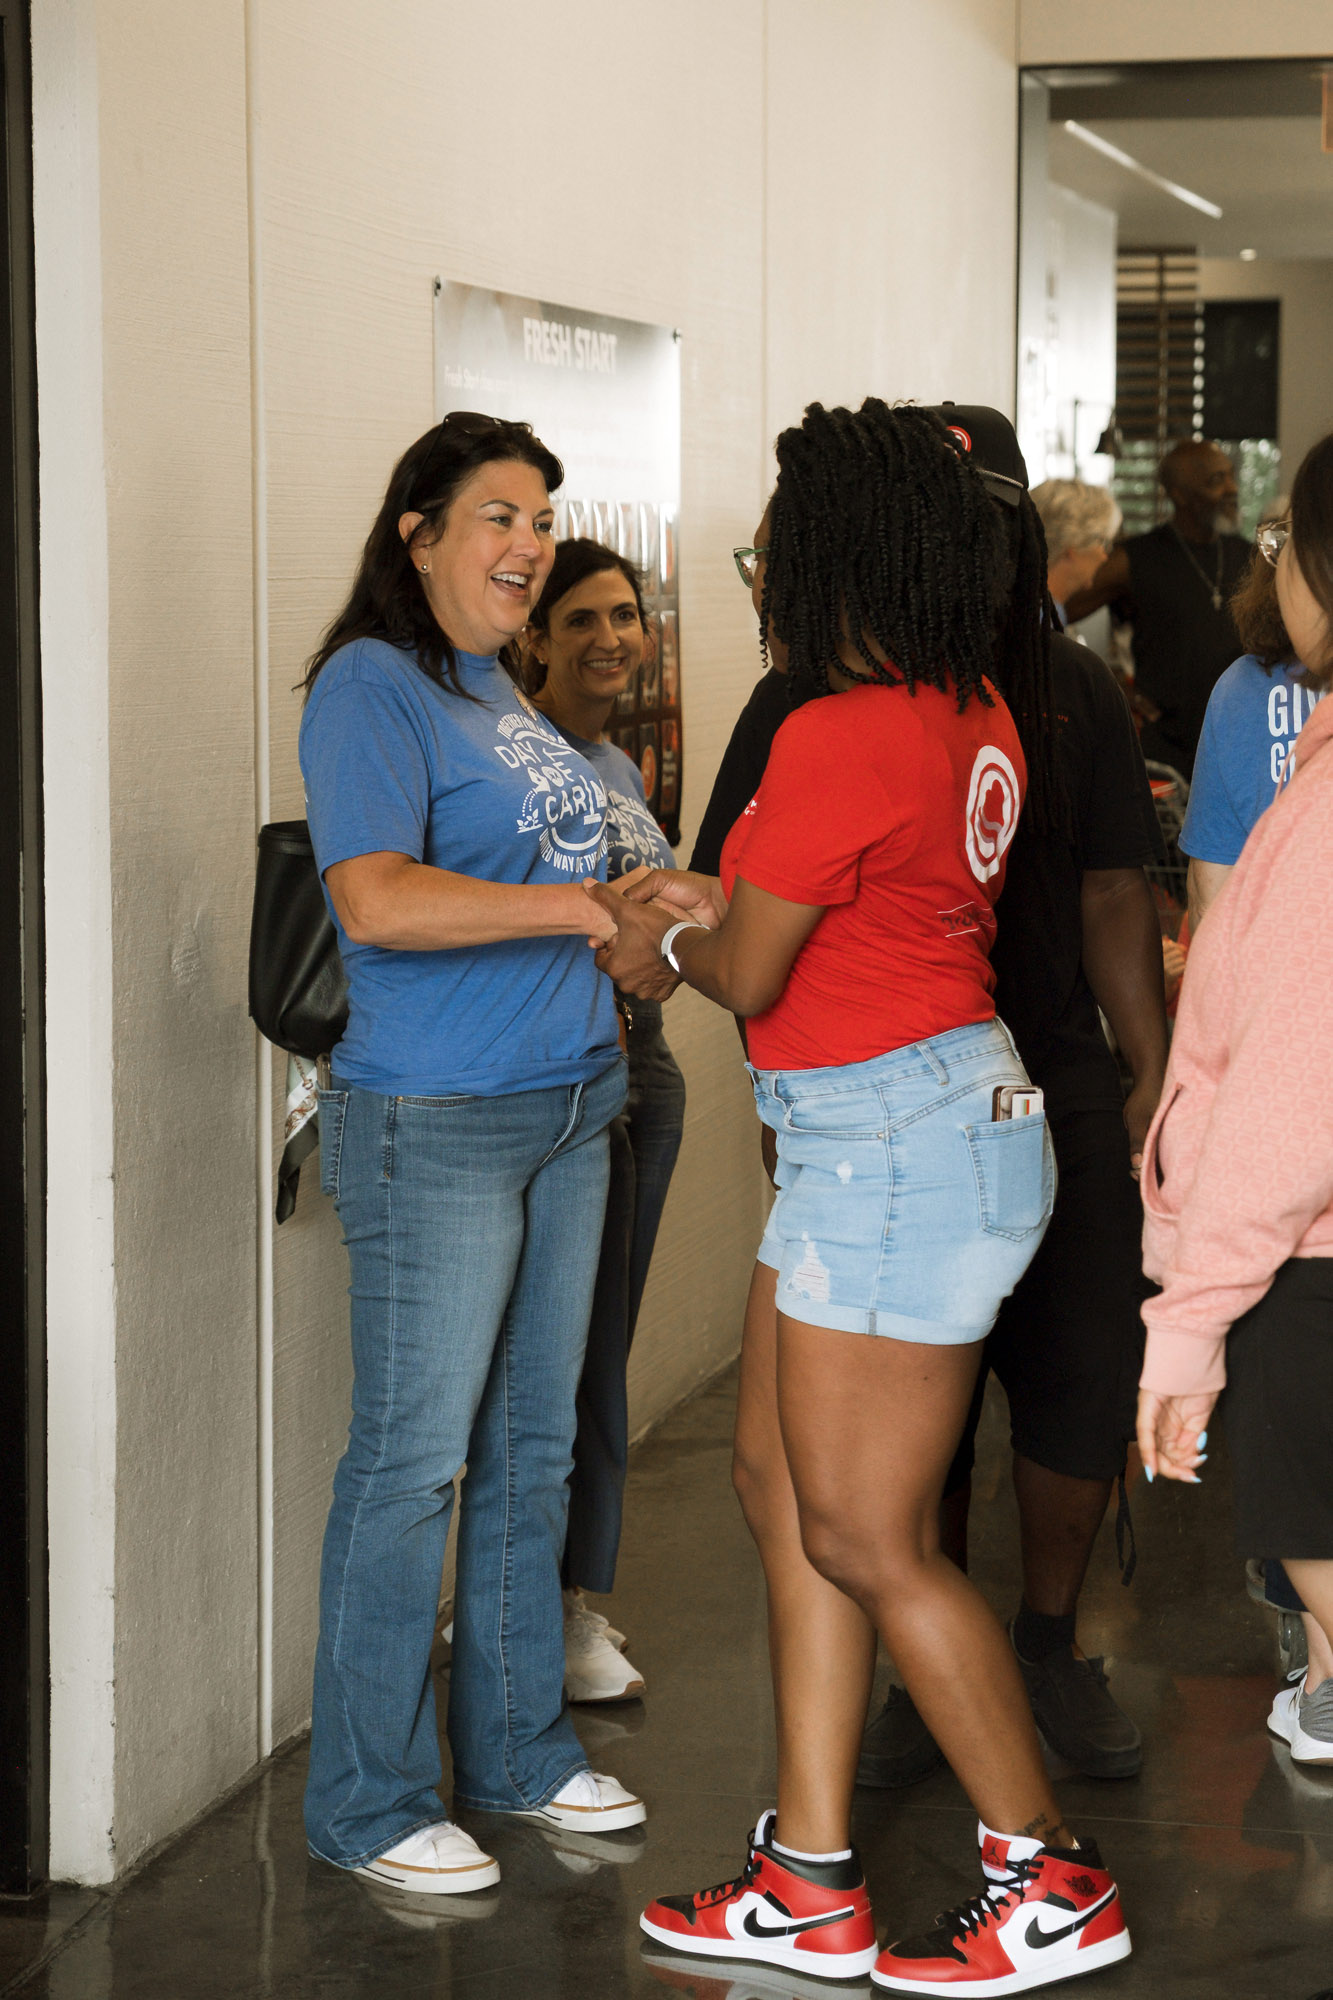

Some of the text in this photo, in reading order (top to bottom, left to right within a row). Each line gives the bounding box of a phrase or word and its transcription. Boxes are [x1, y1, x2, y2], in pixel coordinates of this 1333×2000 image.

[523, 317, 618, 375] FRESH START
[494, 741, 542, 768] DAY
[553, 850, 574, 872] WAY
